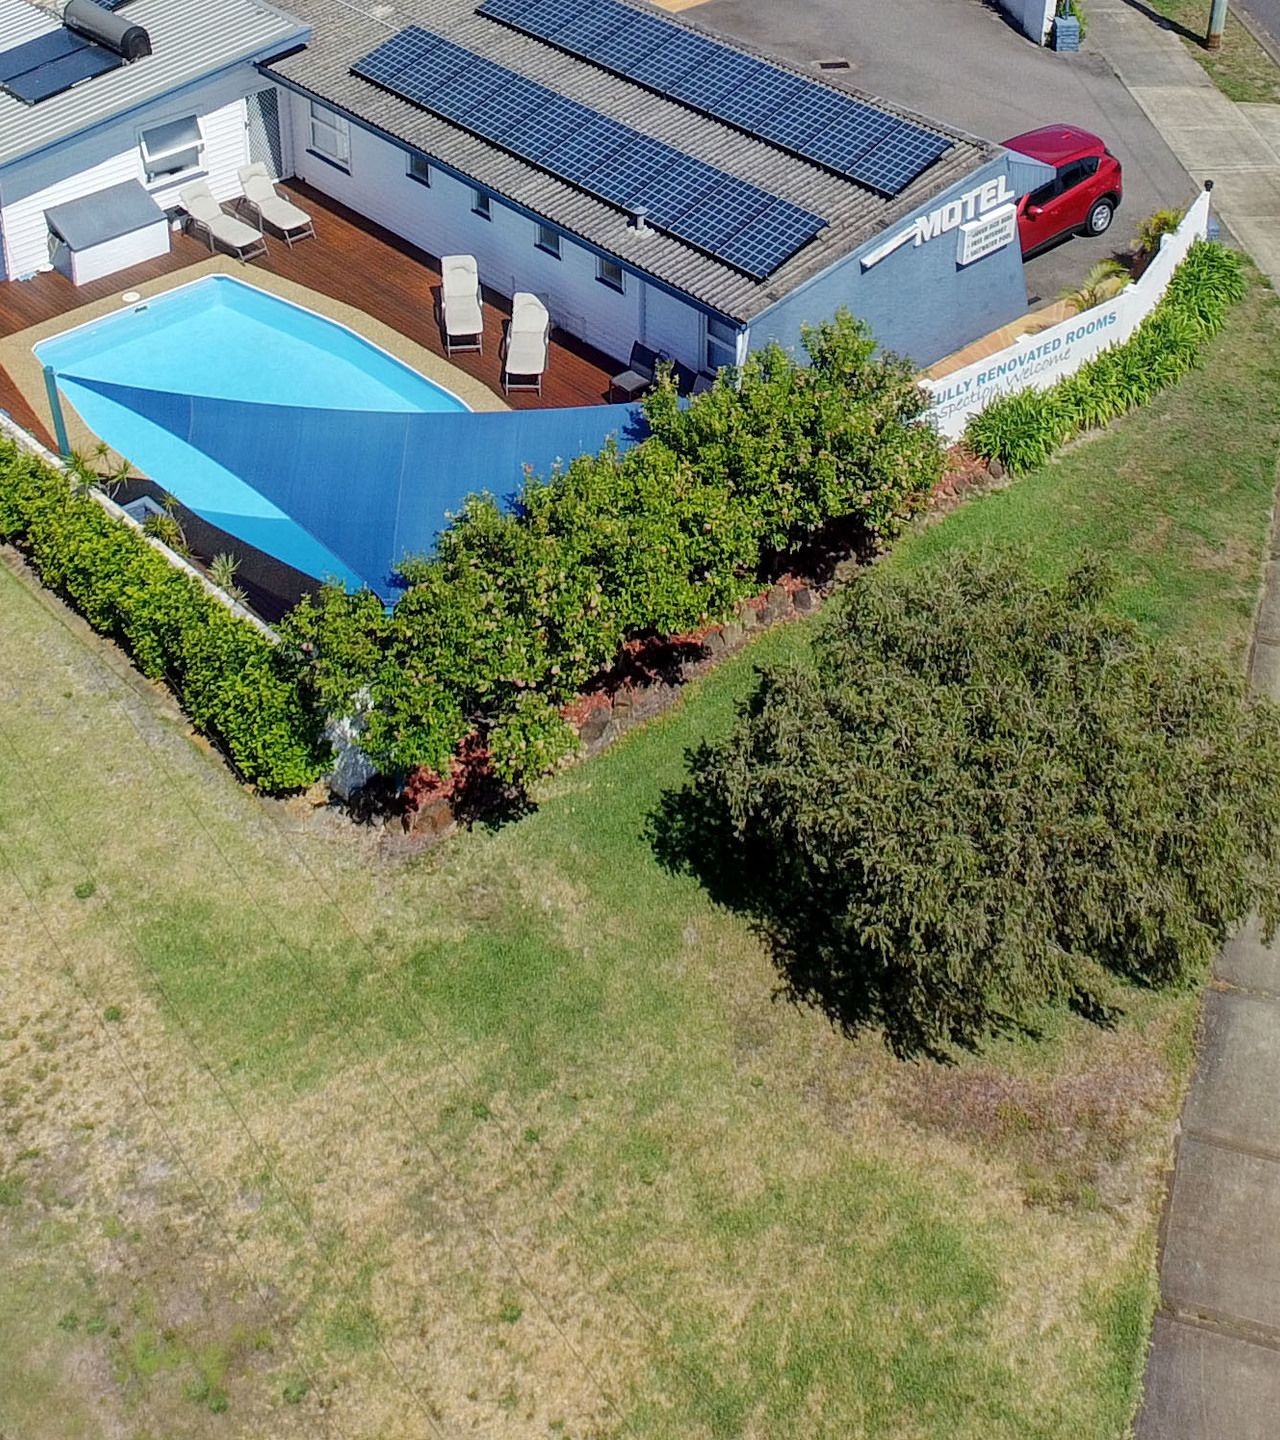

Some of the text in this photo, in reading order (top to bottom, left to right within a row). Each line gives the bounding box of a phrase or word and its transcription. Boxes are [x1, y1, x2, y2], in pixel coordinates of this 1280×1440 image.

[913, 175, 1015, 247] MOTEL
[929, 311, 1117, 407] ULLY RENOVATED ROOMS
[1006, 348, 1071, 386] Welcome
